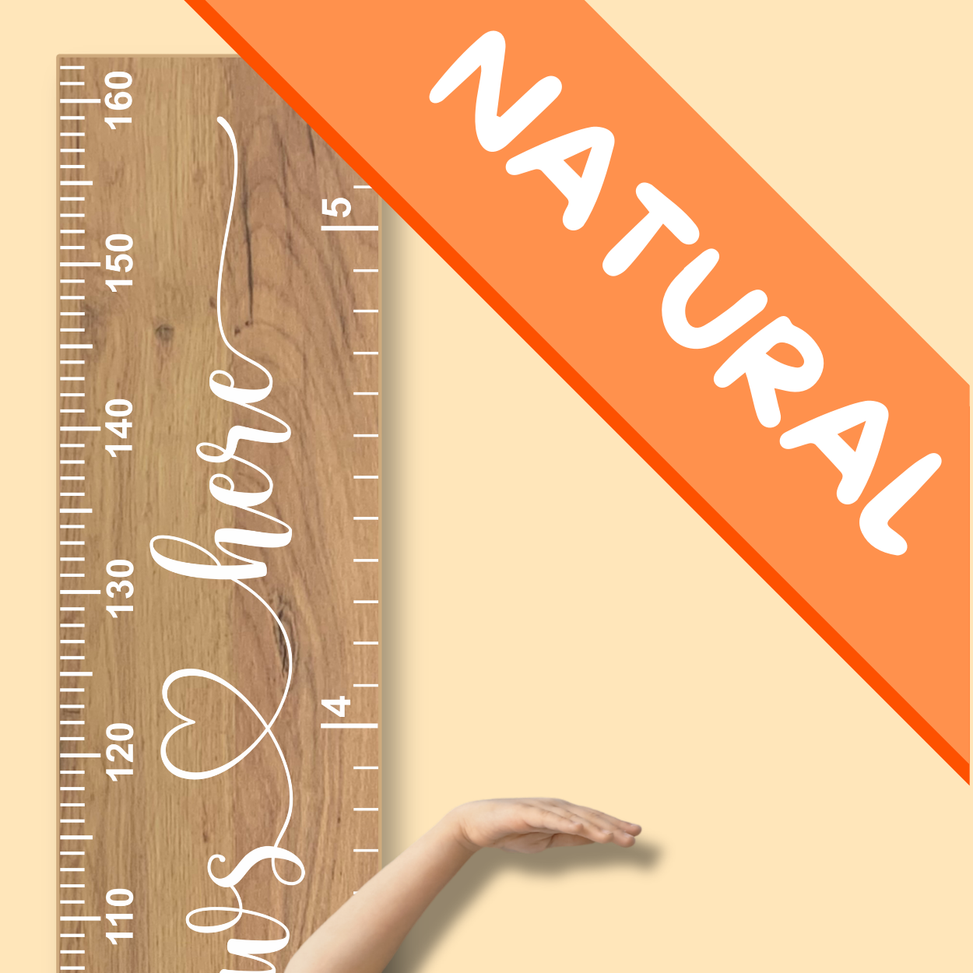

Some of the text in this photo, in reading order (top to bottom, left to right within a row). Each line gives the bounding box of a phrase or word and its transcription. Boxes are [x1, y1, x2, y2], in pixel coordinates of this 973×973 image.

[104, 71, 133, 130] 160
[321, 197, 352, 218] 5
[105, 233, 134, 293] 150
[105, 399, 133, 458] 140
[149, 369, 293, 580] here
[106, 559, 134, 618] 130
[321, 695, 351, 718] 4
[105, 723, 134, 782] 120
[105, 888, 134, 945] 110
